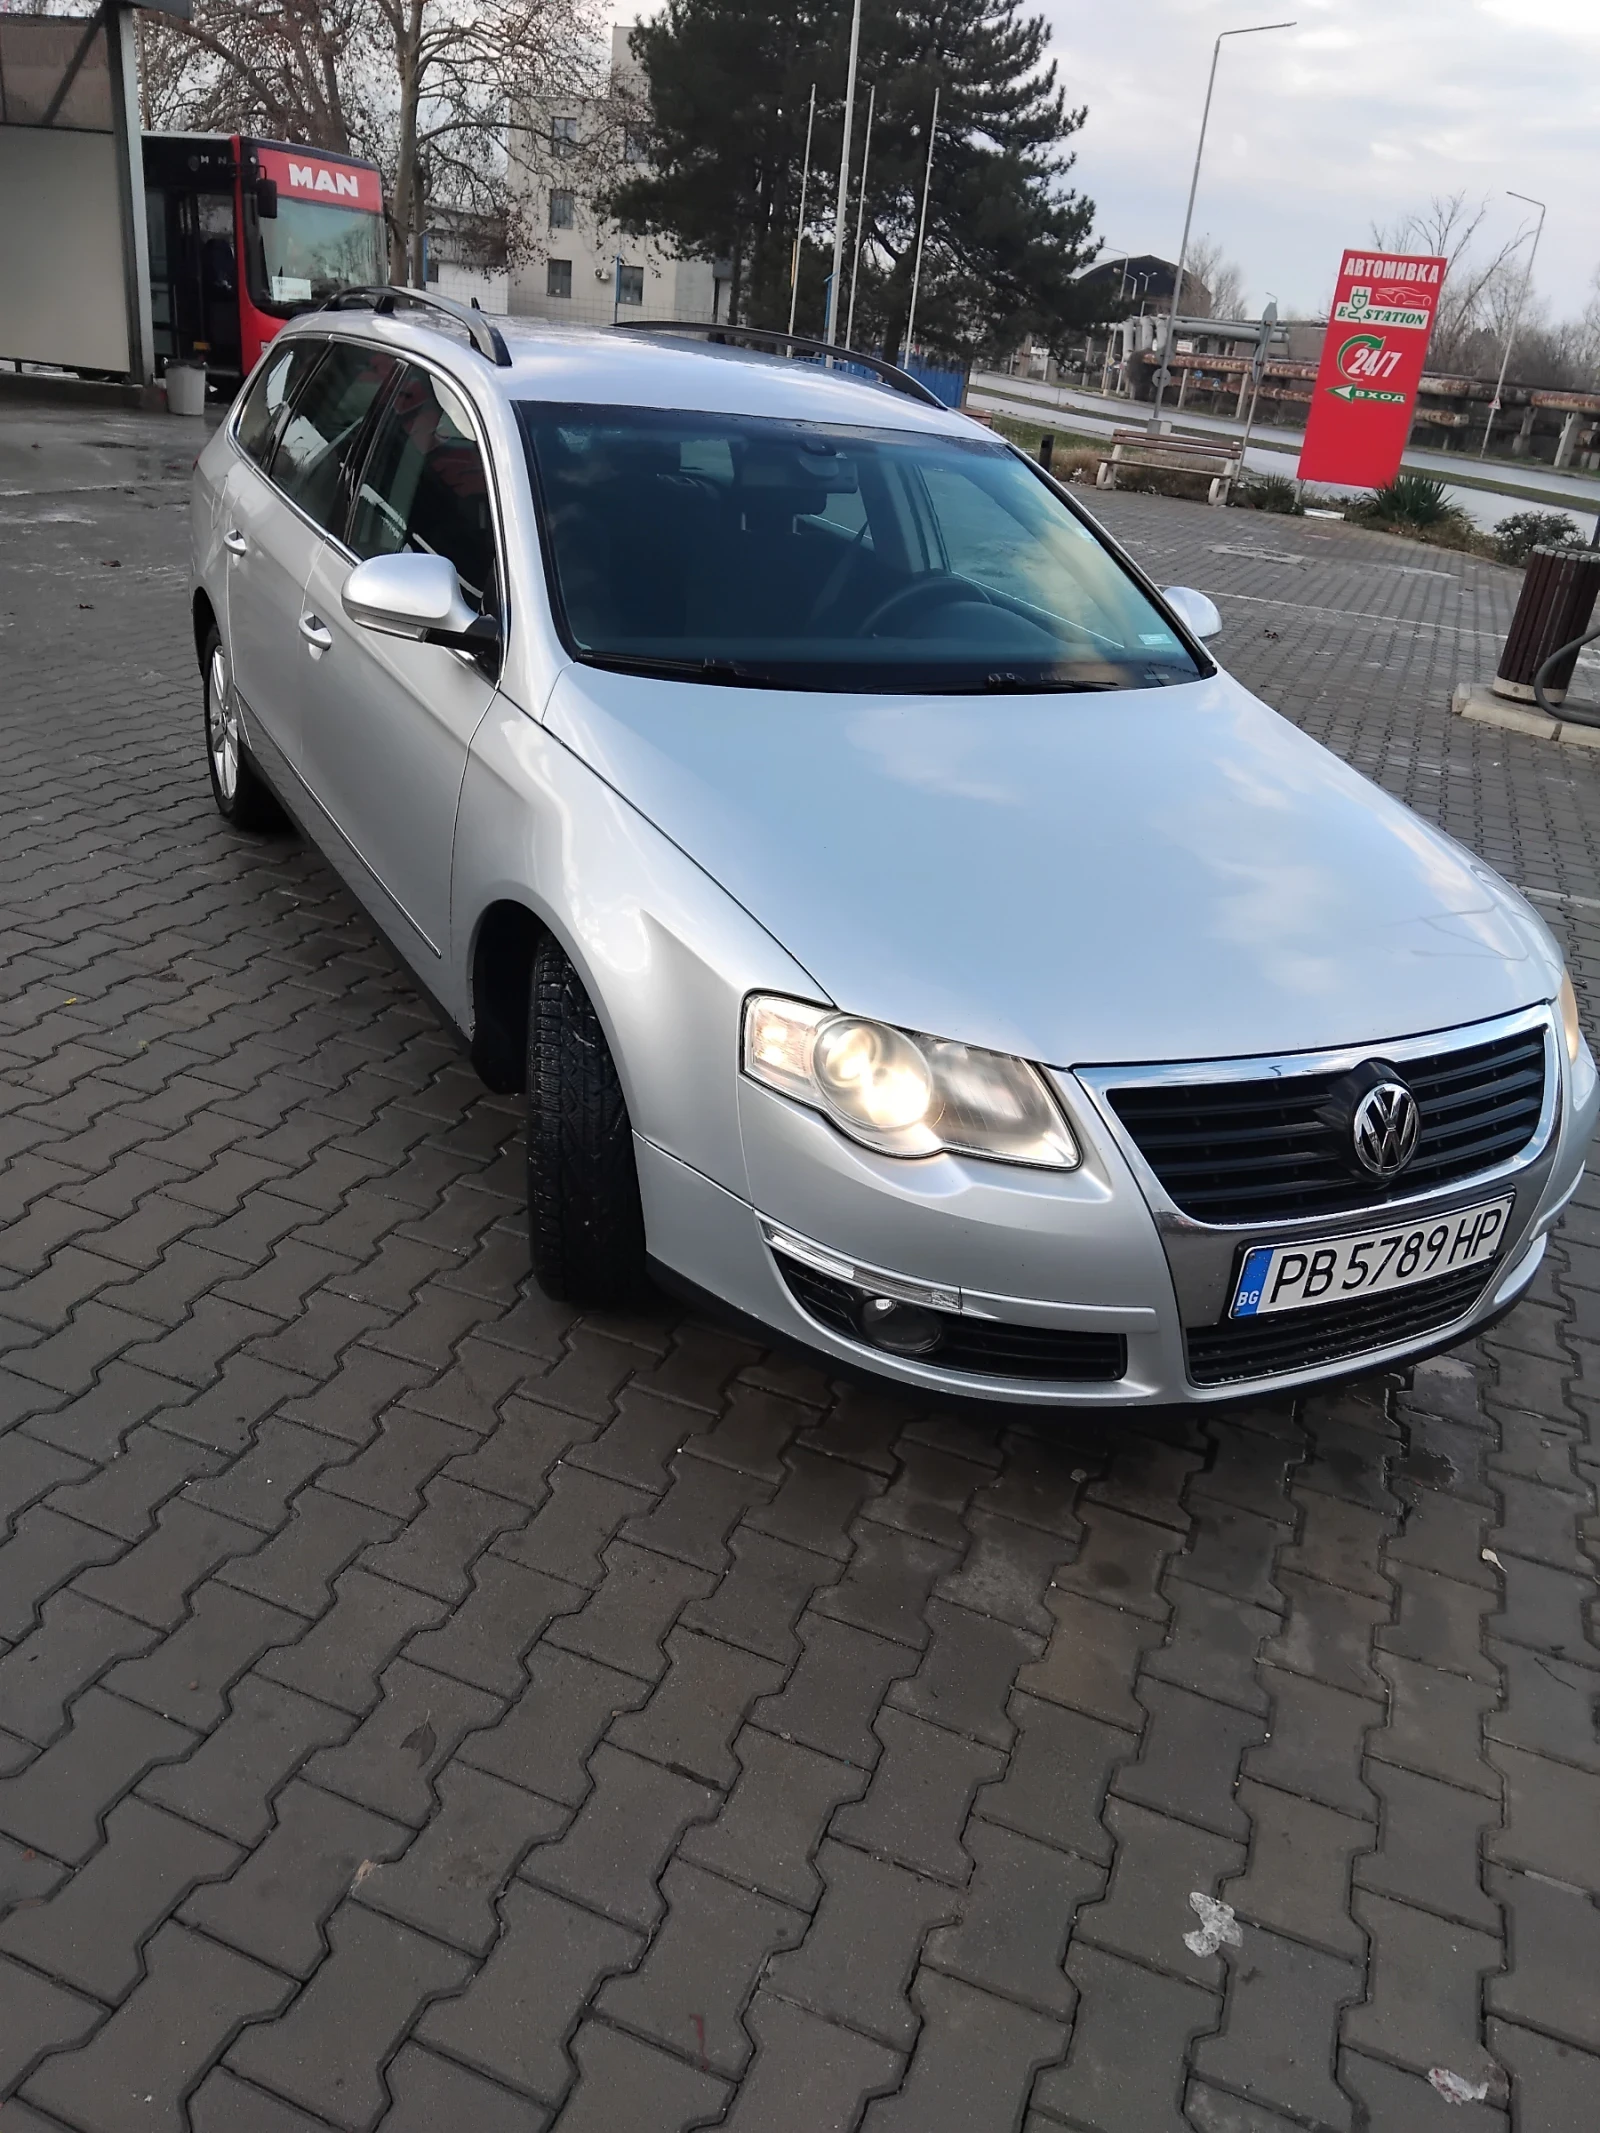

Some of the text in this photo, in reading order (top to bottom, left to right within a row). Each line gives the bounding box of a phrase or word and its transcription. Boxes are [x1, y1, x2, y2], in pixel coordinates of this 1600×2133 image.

[288, 164, 359, 197] MAN
[1344, 258, 1439, 283] АВТОМИВКА
[1363, 309, 1426, 325] STATION
[1347, 349, 1402, 378] 24/7
[1355, 391, 1405, 403] ВХОД
[1342, 1225, 1449, 1290] 5789
[1237, 1291, 1259, 1307] BG
